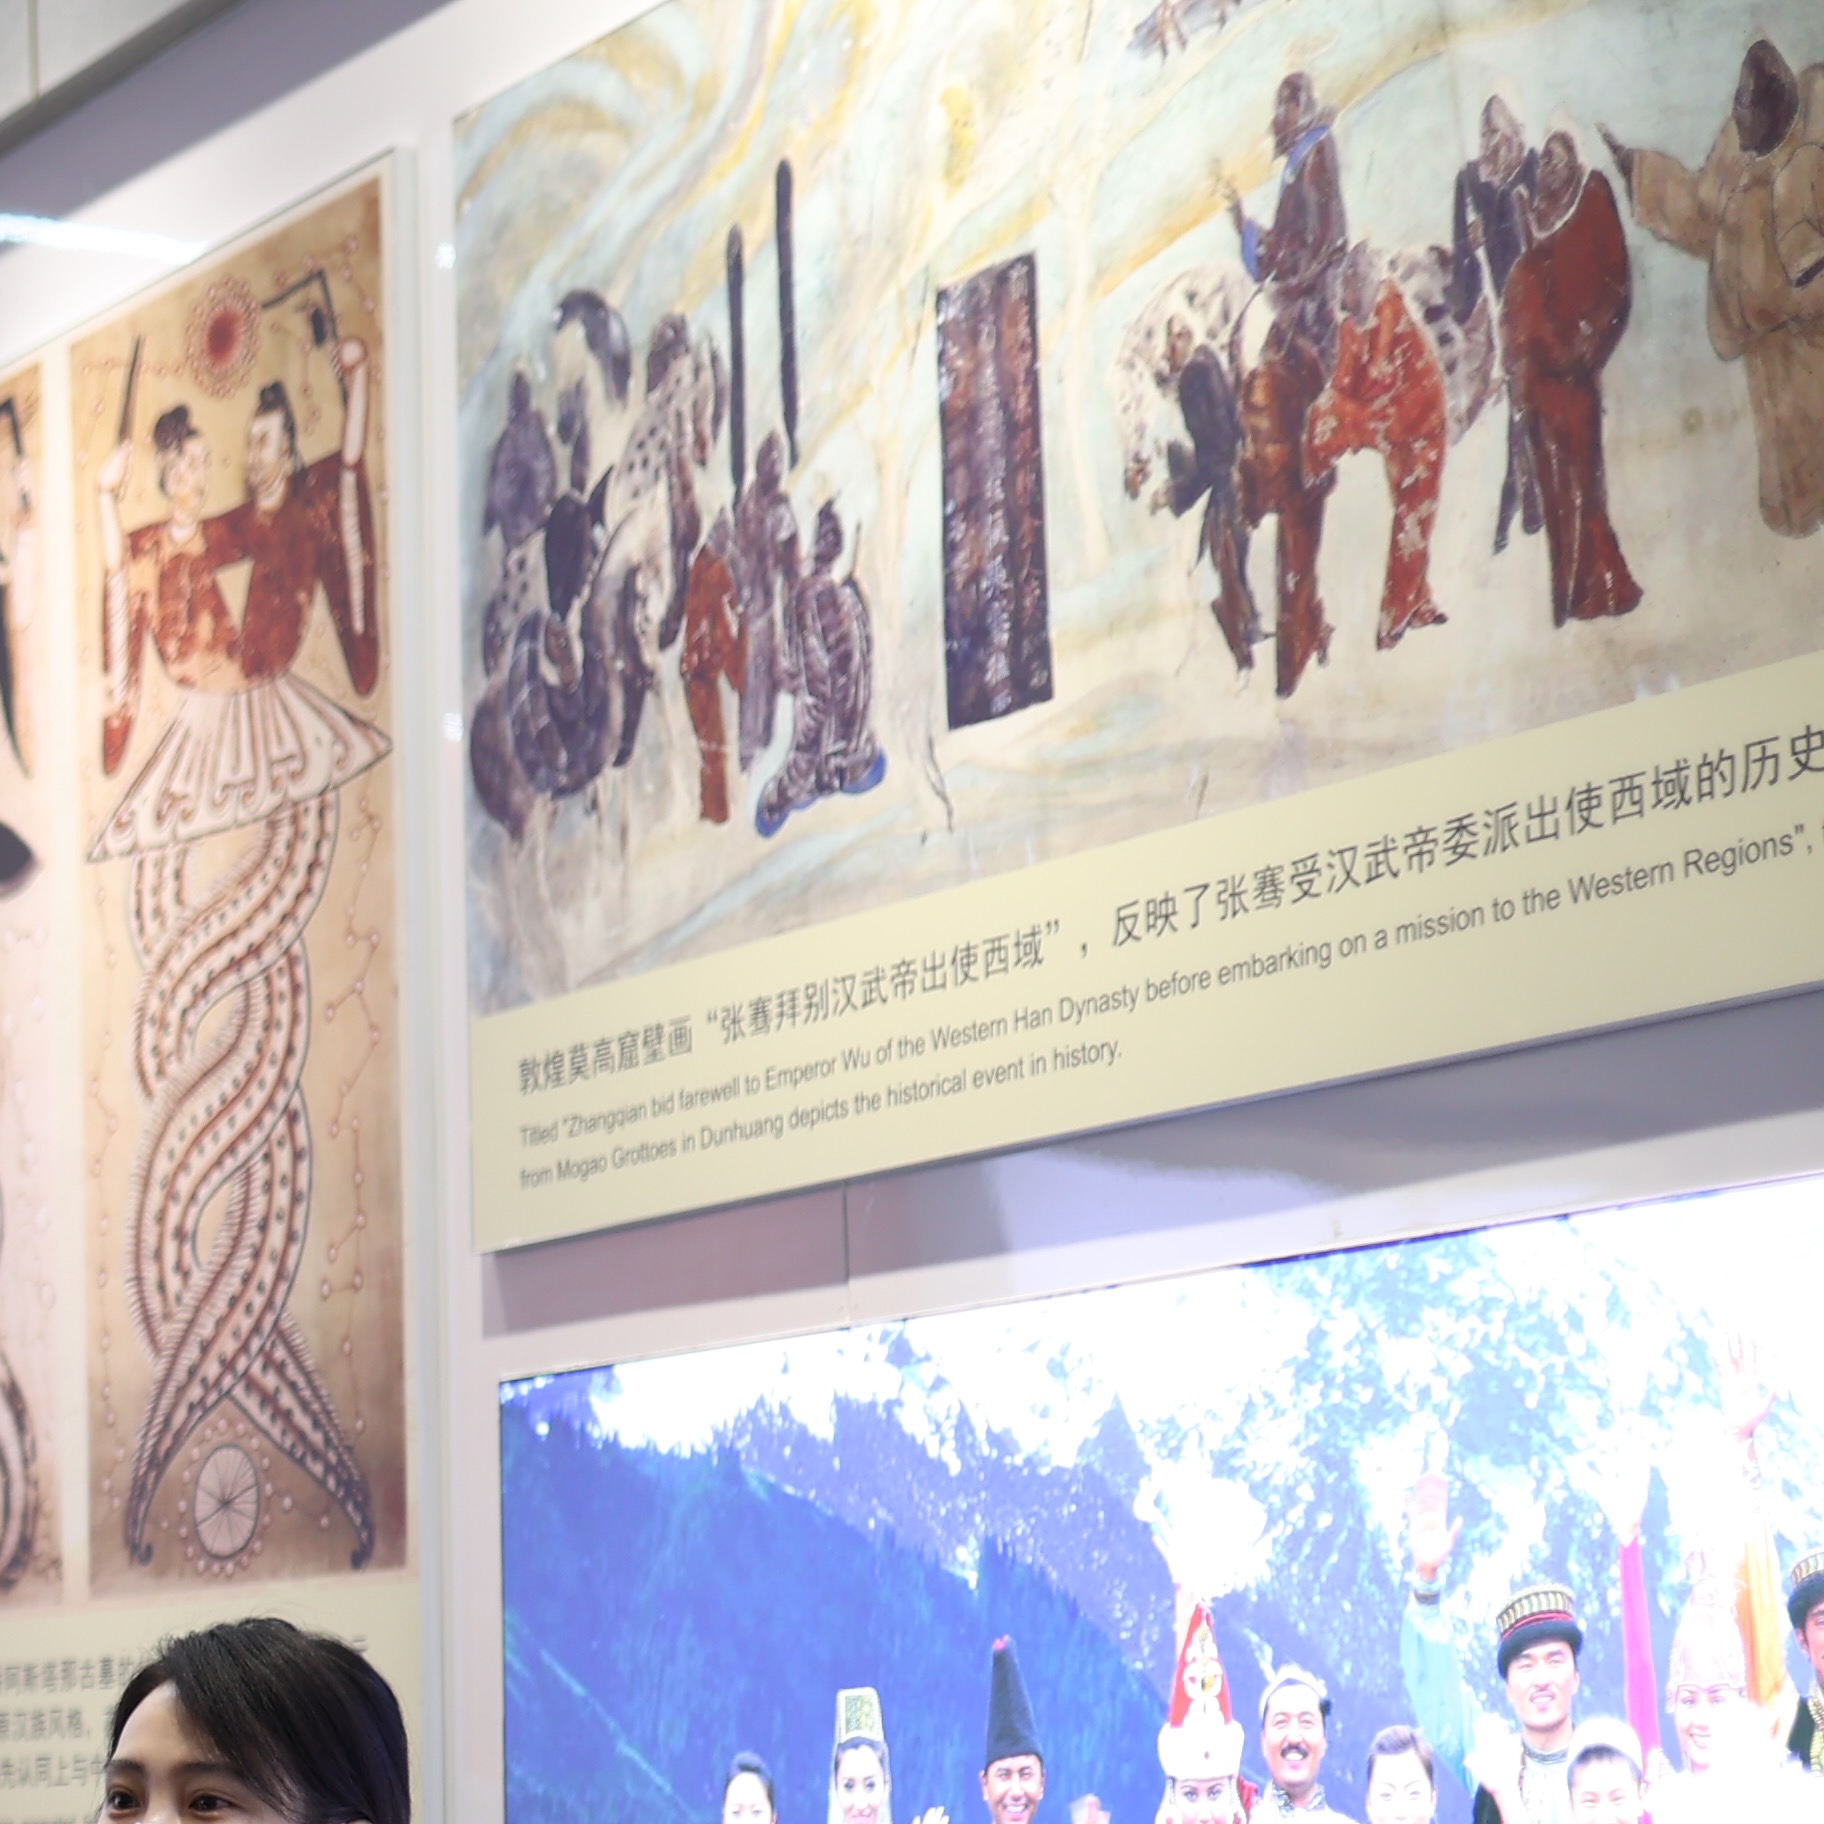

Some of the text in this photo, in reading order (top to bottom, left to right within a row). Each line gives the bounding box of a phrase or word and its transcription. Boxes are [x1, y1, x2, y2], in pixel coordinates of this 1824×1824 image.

[519, 1038, 1123, 1191] from Mogao Grottoes in Dunhuang depicts the historical event in history.
[520, 1118, 559, 1149] Titled
[651, 1092, 676, 1119] bid
[678, 1075, 741, 1111] farewell
[744, 1074, 762, 1095] to
[765, 1056, 837, 1093] Emperor
[842, 1048, 871, 1073] Wu
[876, 1038, 895, 1062] of
[897, 1035, 926, 1061] the
[931, 1016, 1008, 1051] Western
[1013, 1005, 1054, 1033] Han
[1058, 984, 1141, 1026] Dynasty
[1145, 969, 1213, 1003] before
[1217, 942, 1333, 987] embarking
[1338, 933, 1368, 959] on
[1374, 928, 1389, 951] a
[1395, 905, 1486, 946] mission
[1492, 896, 1517, 924] to
[1522, 886, 1562, 917] the
[1566, 860, 1675, 906] Western
